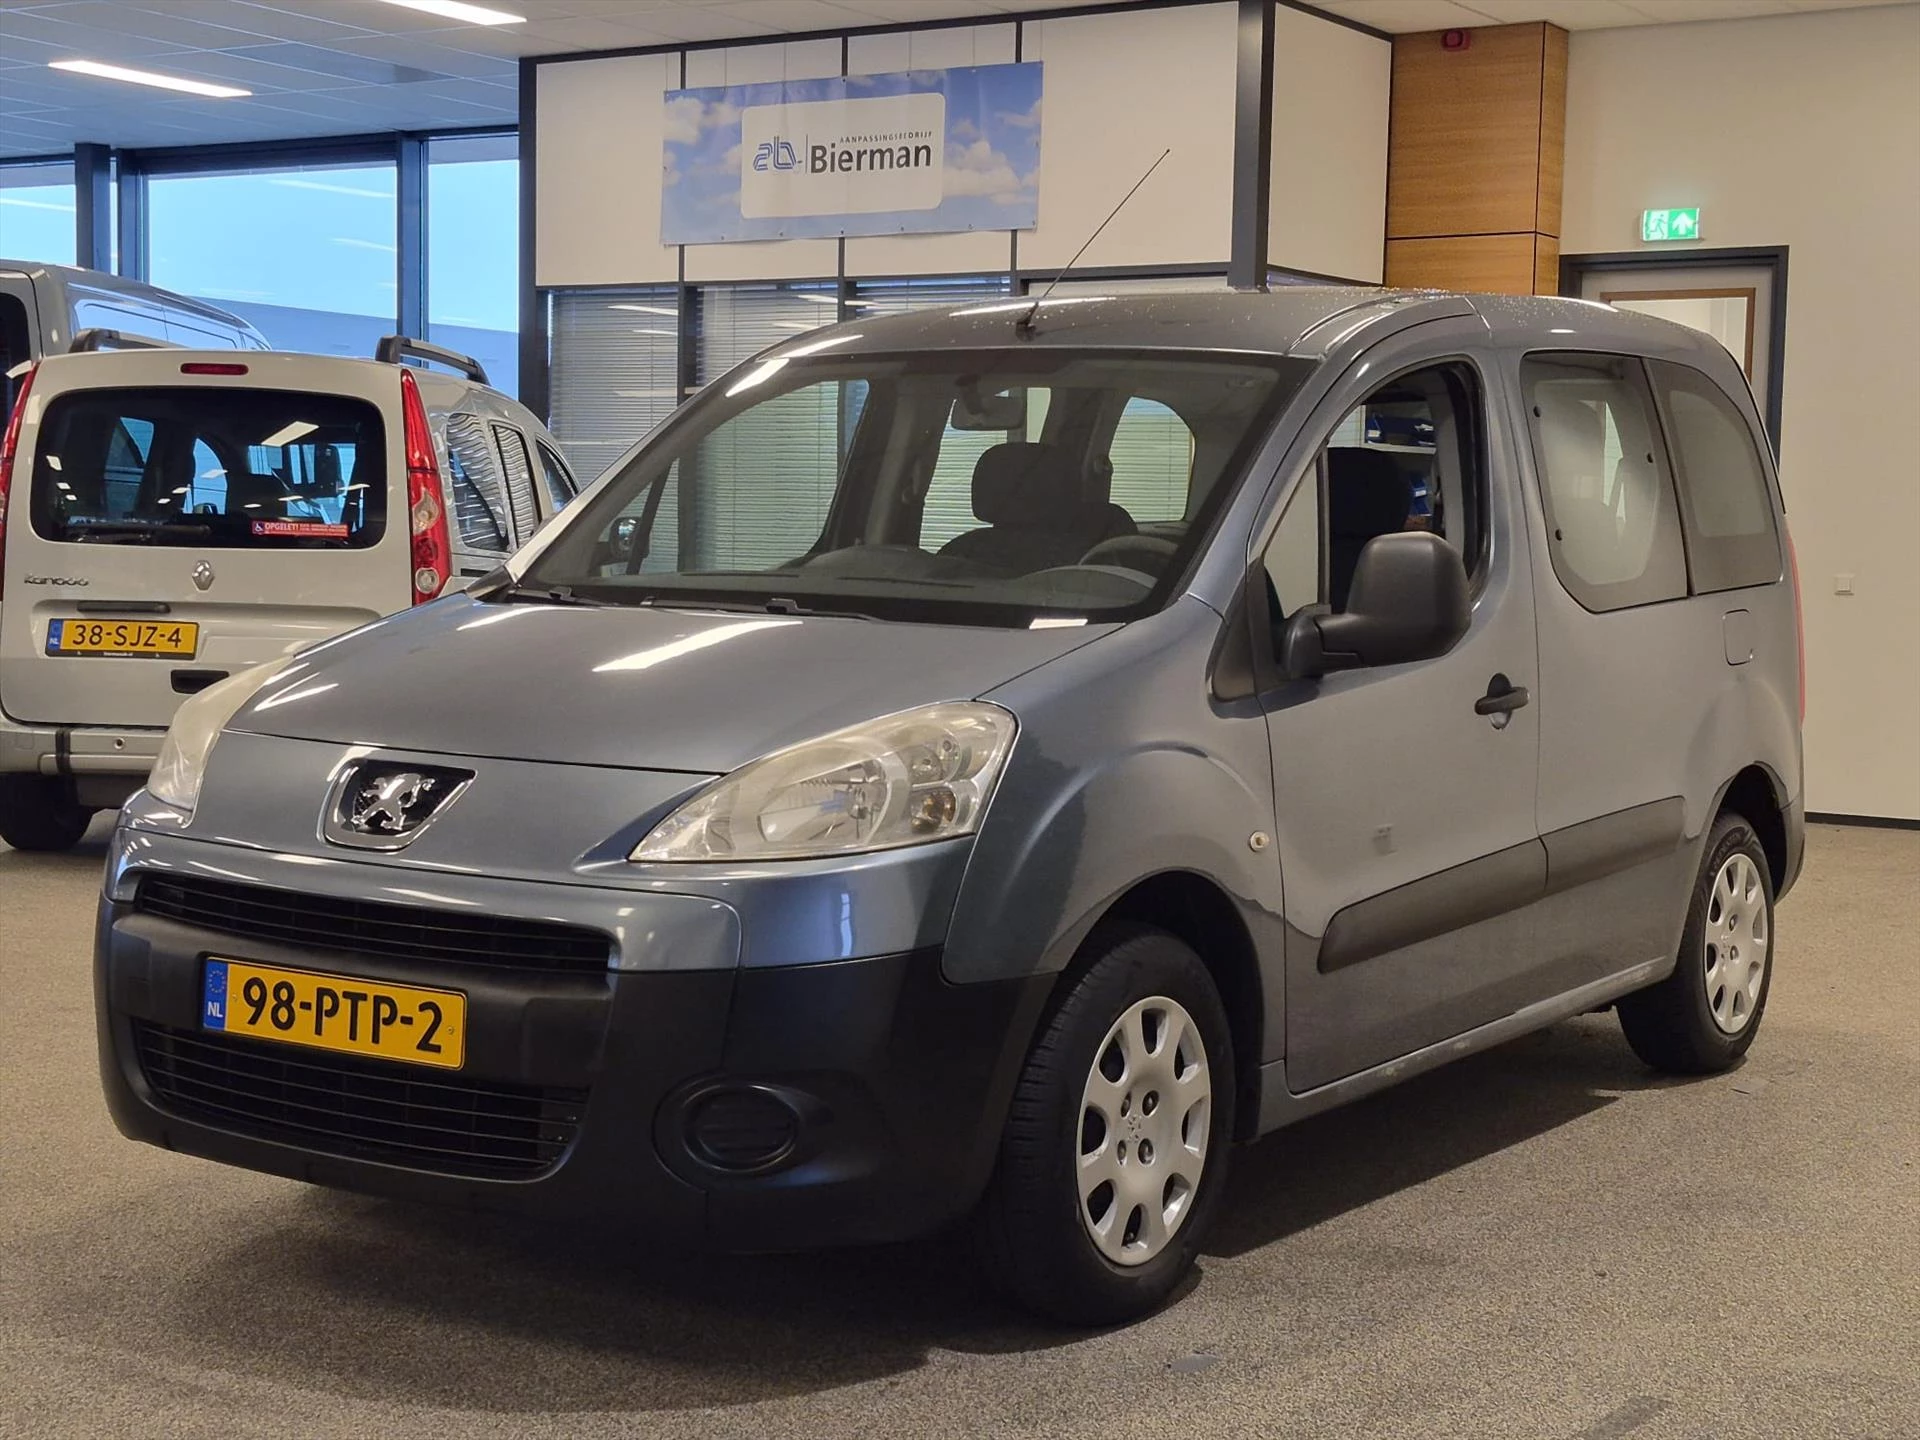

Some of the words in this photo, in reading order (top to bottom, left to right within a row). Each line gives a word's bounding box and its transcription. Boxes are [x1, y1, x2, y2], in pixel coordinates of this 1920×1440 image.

[840, 131, 932, 144] AANPASSINGSBEDRIJF
[810, 143, 931, 173] Bierman
[49, 637, 59, 645] NL
[72, 624, 182, 648] 38-SJZ-4
[207, 1001, 224, 1018] NL
[242, 976, 443, 1054] 98-PTP-2
